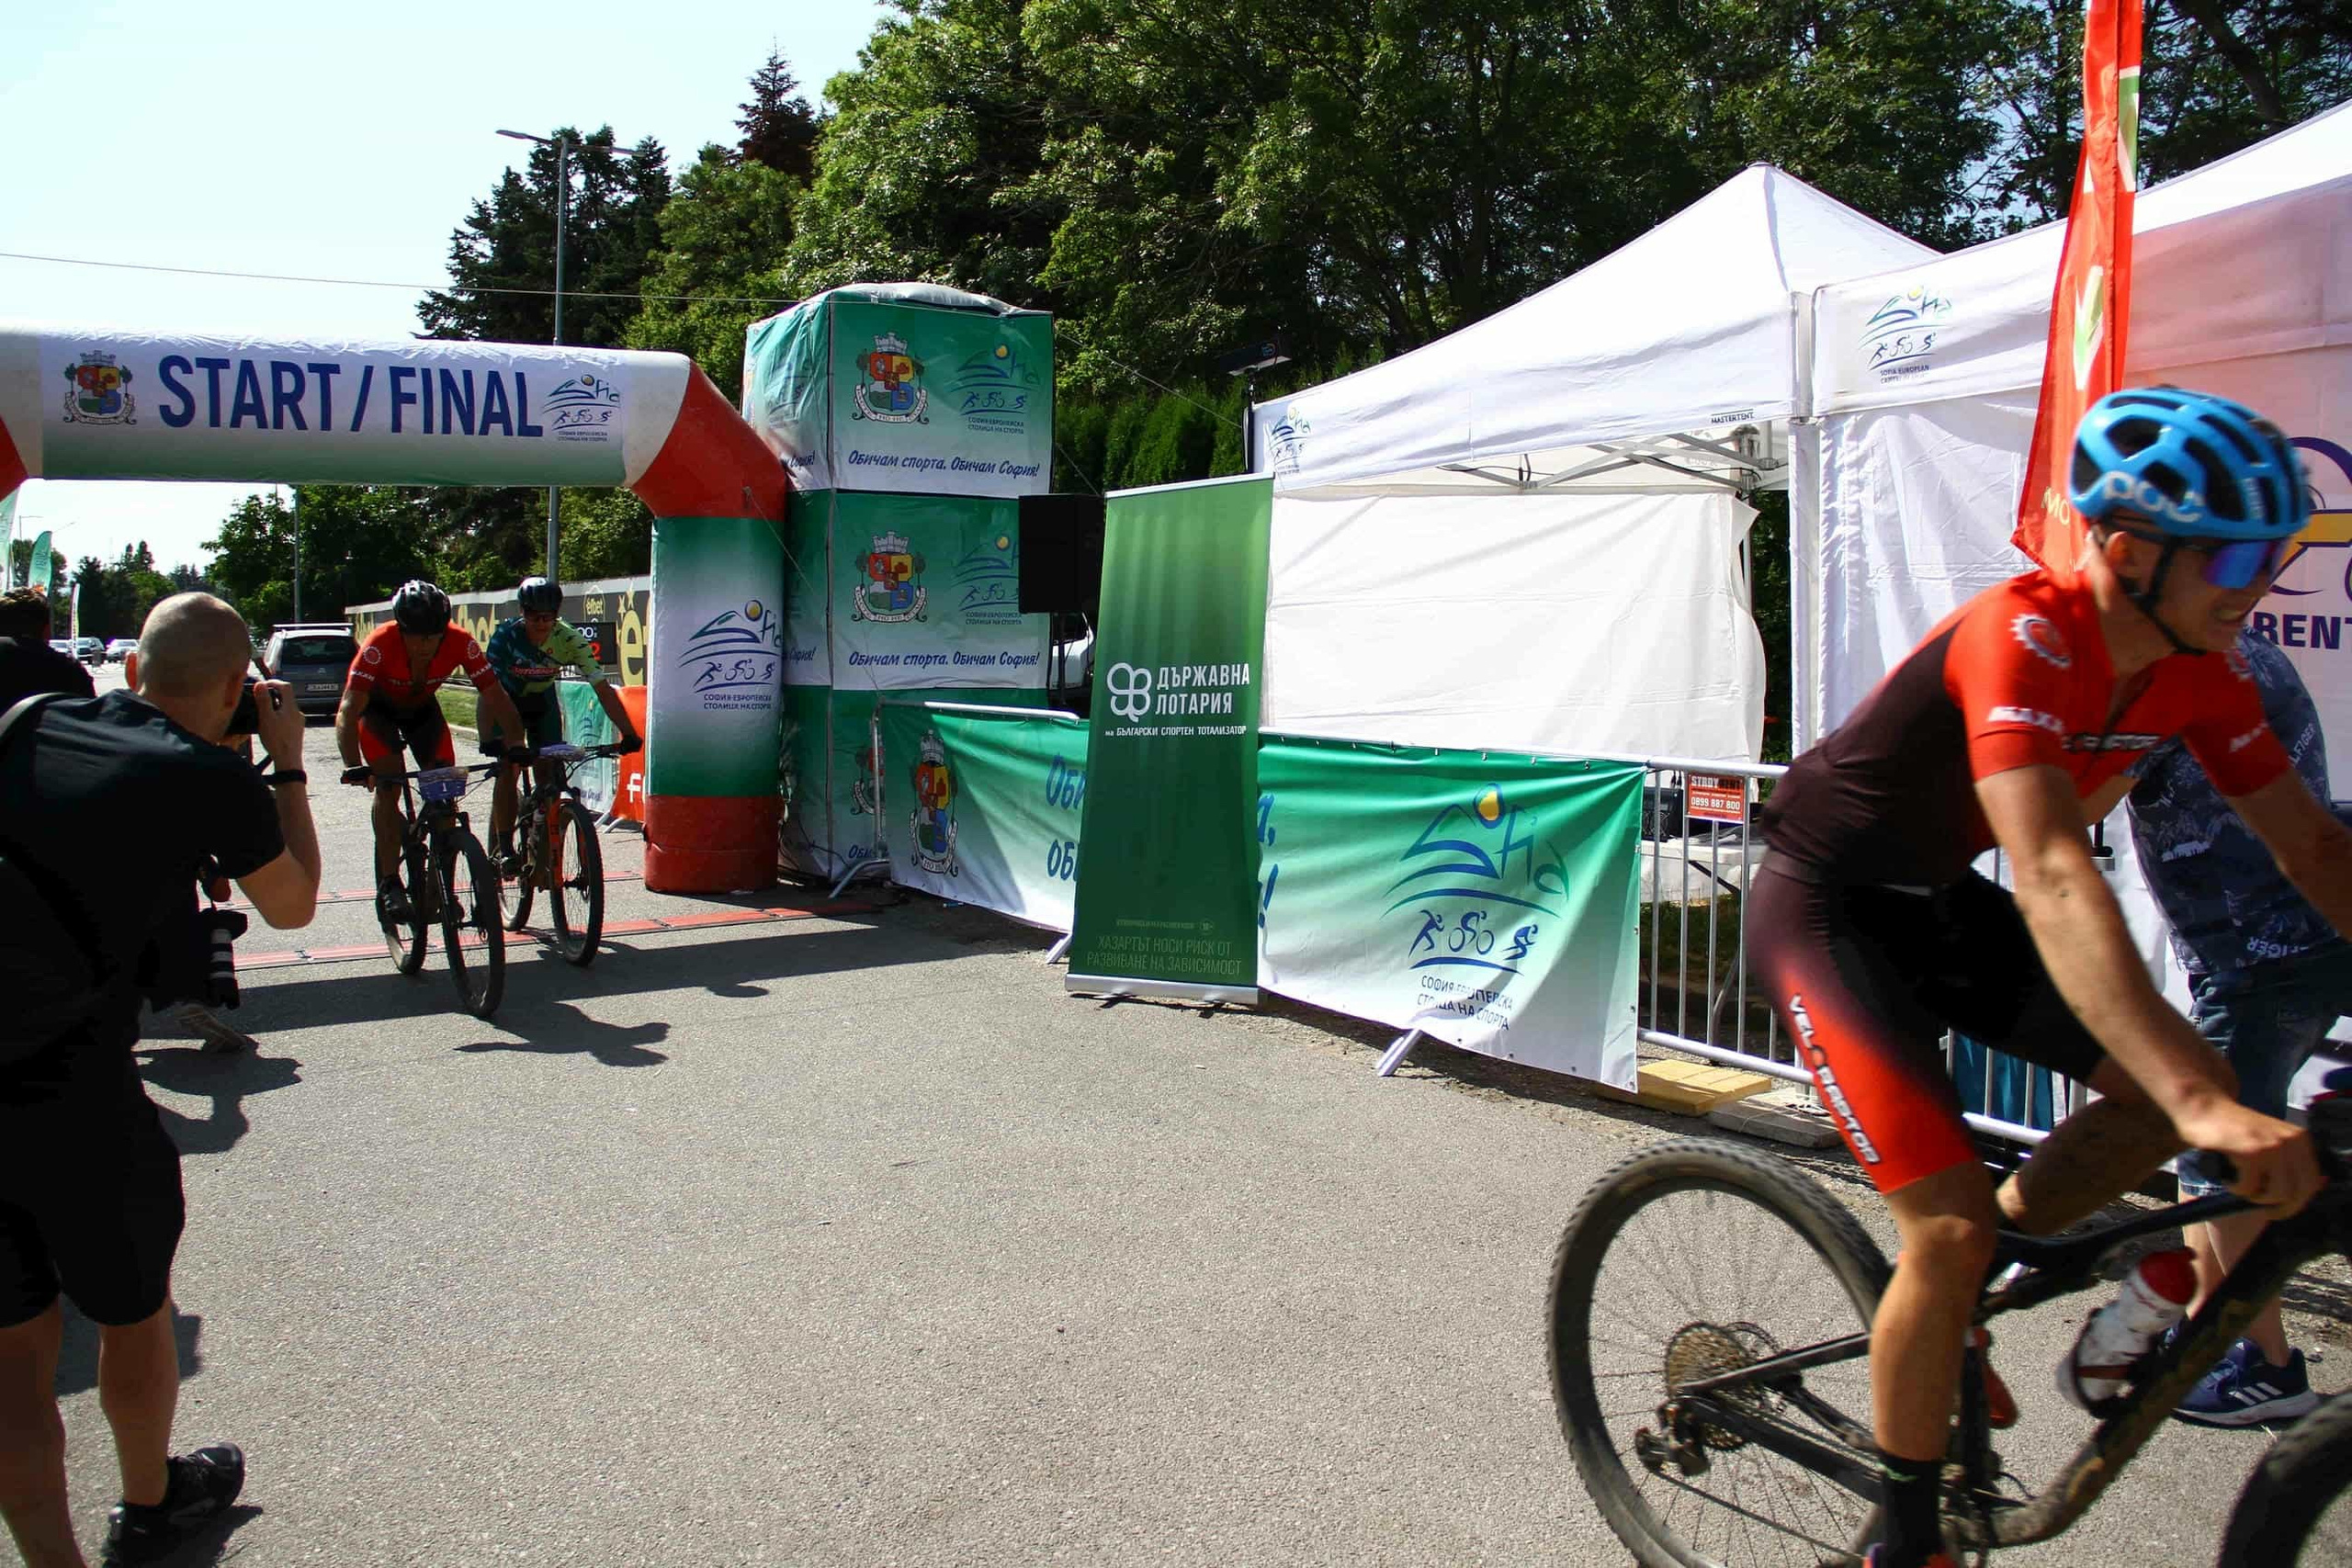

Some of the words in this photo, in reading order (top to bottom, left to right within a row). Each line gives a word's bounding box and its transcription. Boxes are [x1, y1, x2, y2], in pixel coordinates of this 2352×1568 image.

[158, 355, 341, 431] START
[390, 367, 543, 437] FINAL
[1711, 412, 1754, 423] MASTERTENT
[848, 450, 898, 466] Обичам
[901, 457, 946, 472] спорта.
[951, 457, 996, 473] Обичам
[999, 460, 1040, 478] София!
[2252, 611, 2352, 650] REN
[848, 651, 899, 666] Обичам
[902, 652, 948, 670] спорта.
[953, 651, 996, 666] Обичам
[999, 651, 1040, 669] София!
[1157, 663, 1250, 690] ДЪРЖАВНА
[1155, 693, 1232, 715] ЛОТАРИЯ
[1116, 727, 1159, 737] БЪЛГАРСКИ
[1160, 727, 1194, 736] СПОРТЕН
[1197, 726, 1248, 736] ТОТАЛИЗАТОР
[1154, 938, 1183, 953] НОСИ
[1185, 939, 1215, 956] РИСК
[1217, 941, 1232, 957] ОТ
[1458, 1002, 1474, 1017] НА
